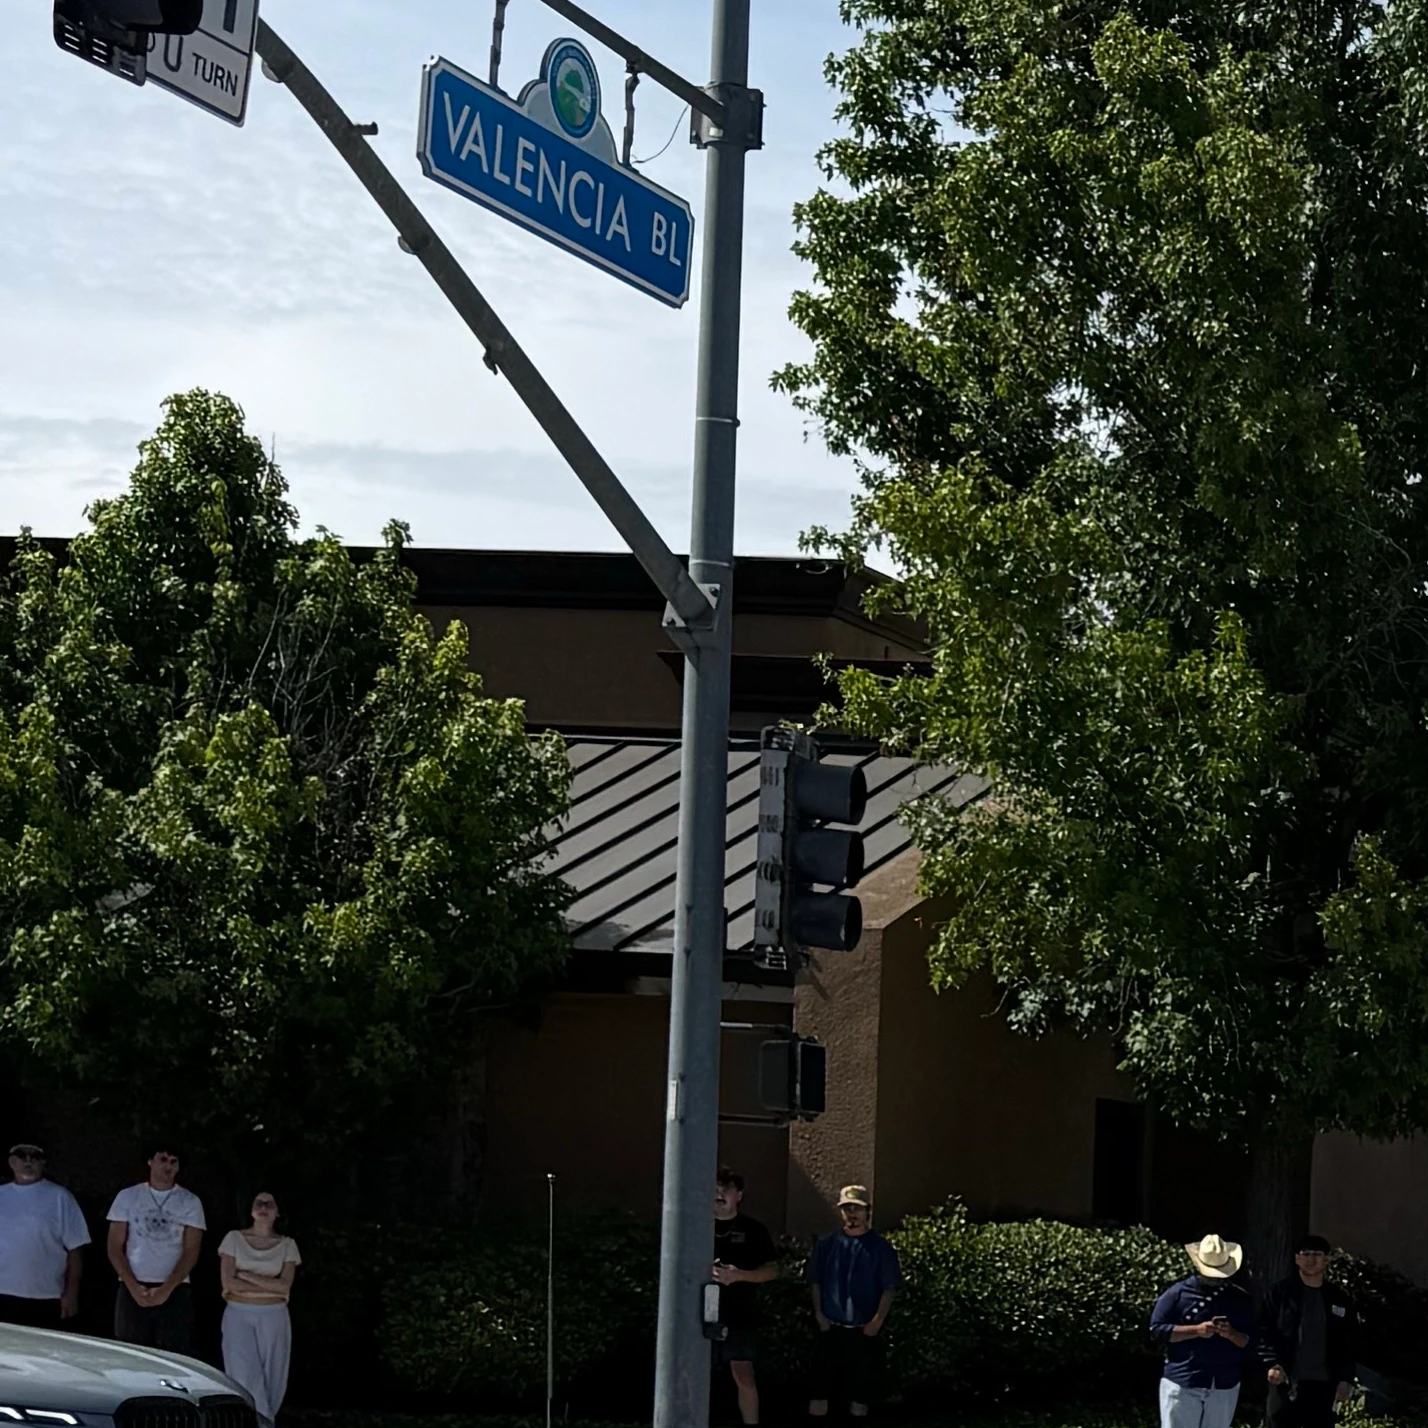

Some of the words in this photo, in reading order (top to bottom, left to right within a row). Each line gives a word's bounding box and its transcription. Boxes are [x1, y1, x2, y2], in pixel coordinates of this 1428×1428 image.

[192, 51, 238, 97] TURN
[443, 91, 632, 252] VALENCIA
[651, 211, 682, 267] BL
